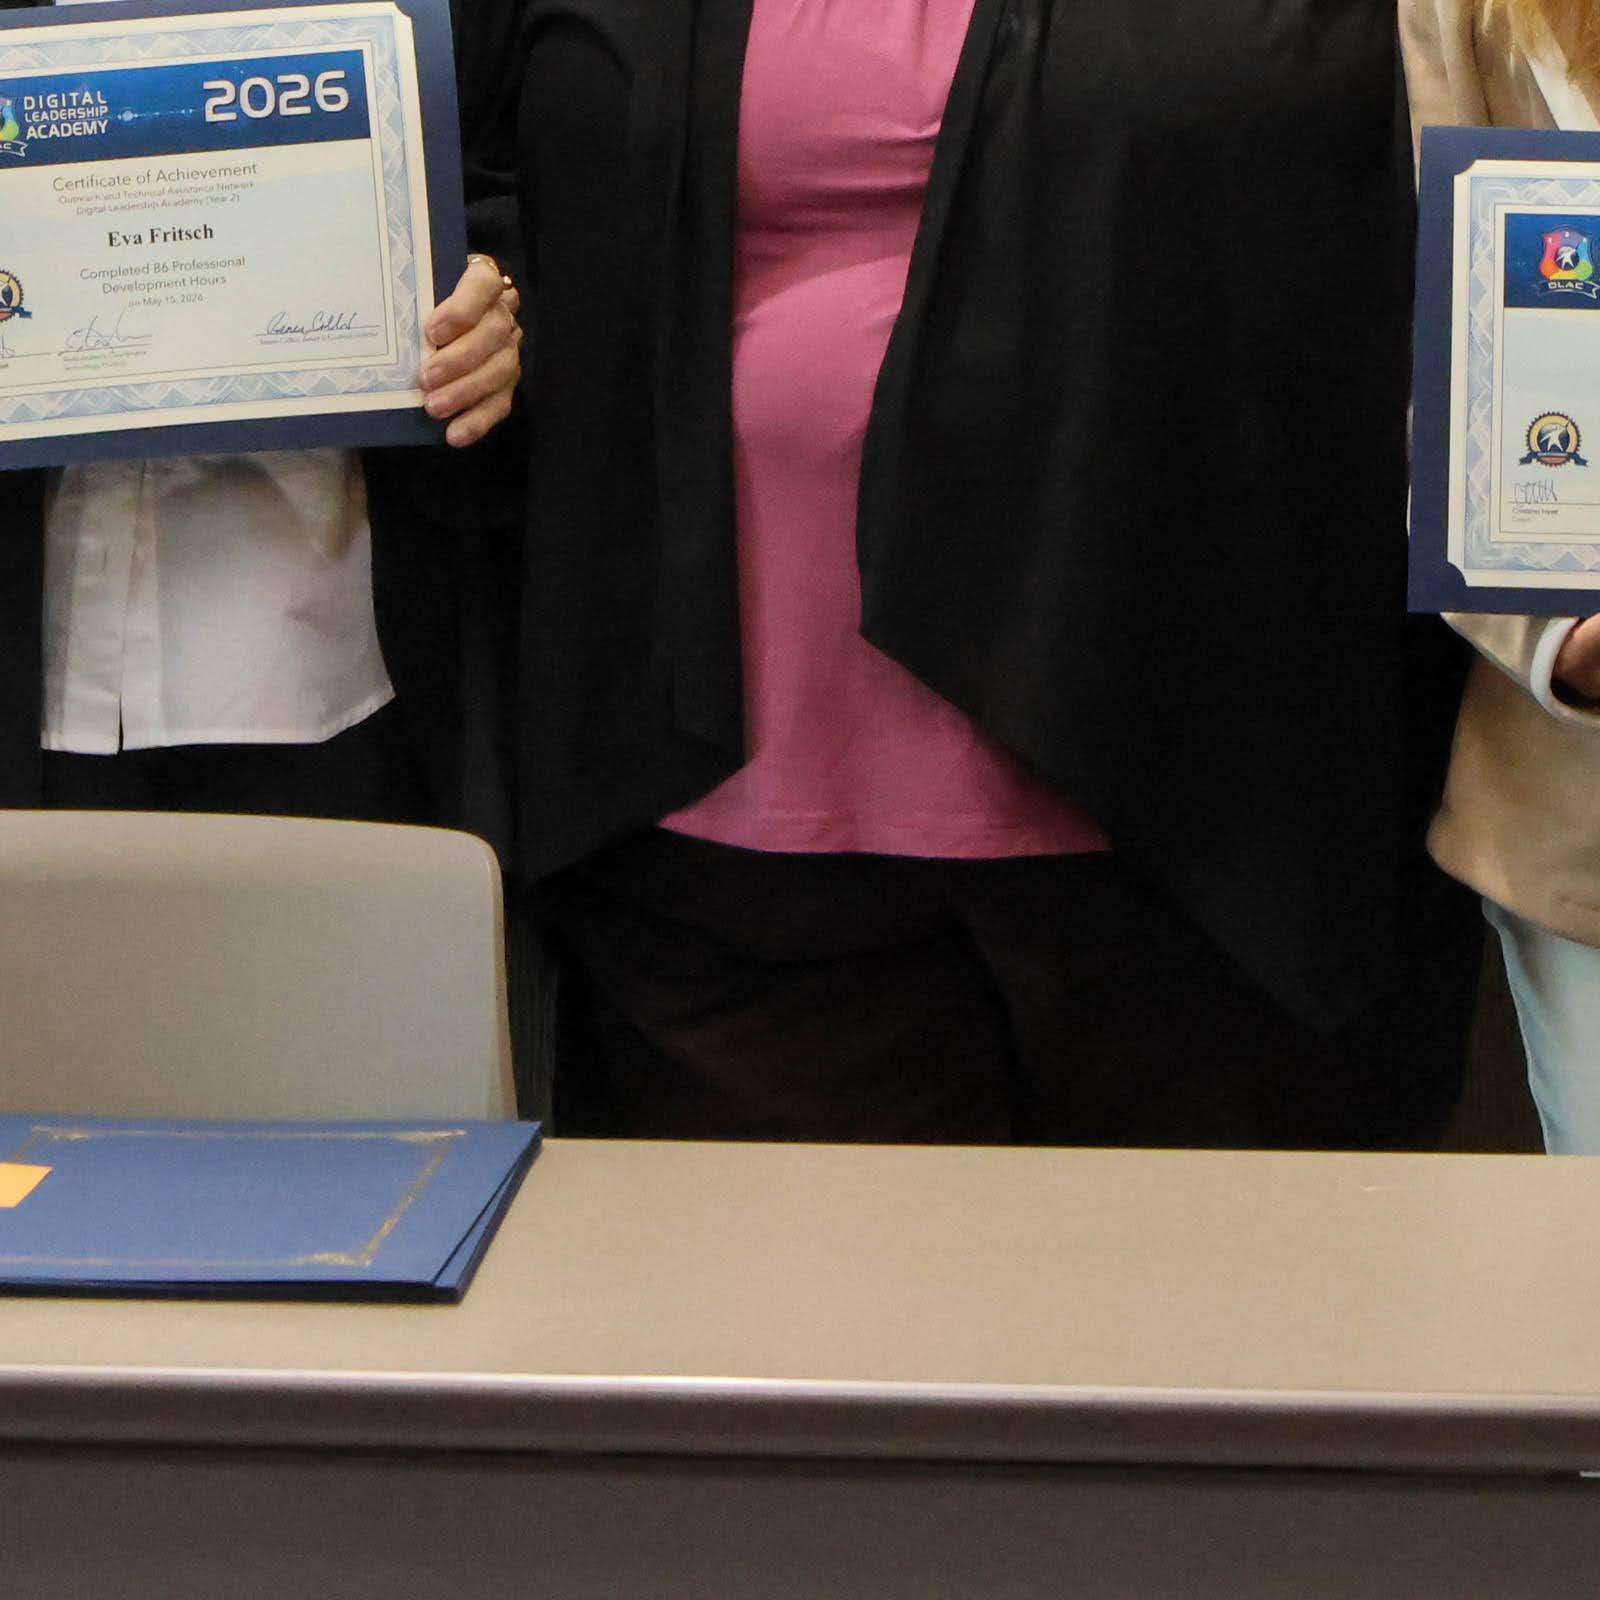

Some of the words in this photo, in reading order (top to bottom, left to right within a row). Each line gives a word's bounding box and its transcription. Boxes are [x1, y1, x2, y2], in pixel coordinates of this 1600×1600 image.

[24, 91, 107, 109] DIGITAL
[203, 71, 349, 122] 2026
[25, 106, 108, 123] LEADERSHIP
[26, 120, 108, 140] ACADEMY
[53, 174, 131, 191] Certificate
[136, 169, 151, 184] of
[156, 164, 257, 182] Achievement
[108, 231, 142, 247] Eva
[150, 224, 214, 244] Fritsch
[80, 264, 150, 280] Completed
[154, 265, 168, 273] 86
[172, 256, 246, 271] Professional
[102, 279, 187, 295] Development
[190, 274, 226, 285] Hours
[143, 298, 162, 307] May
